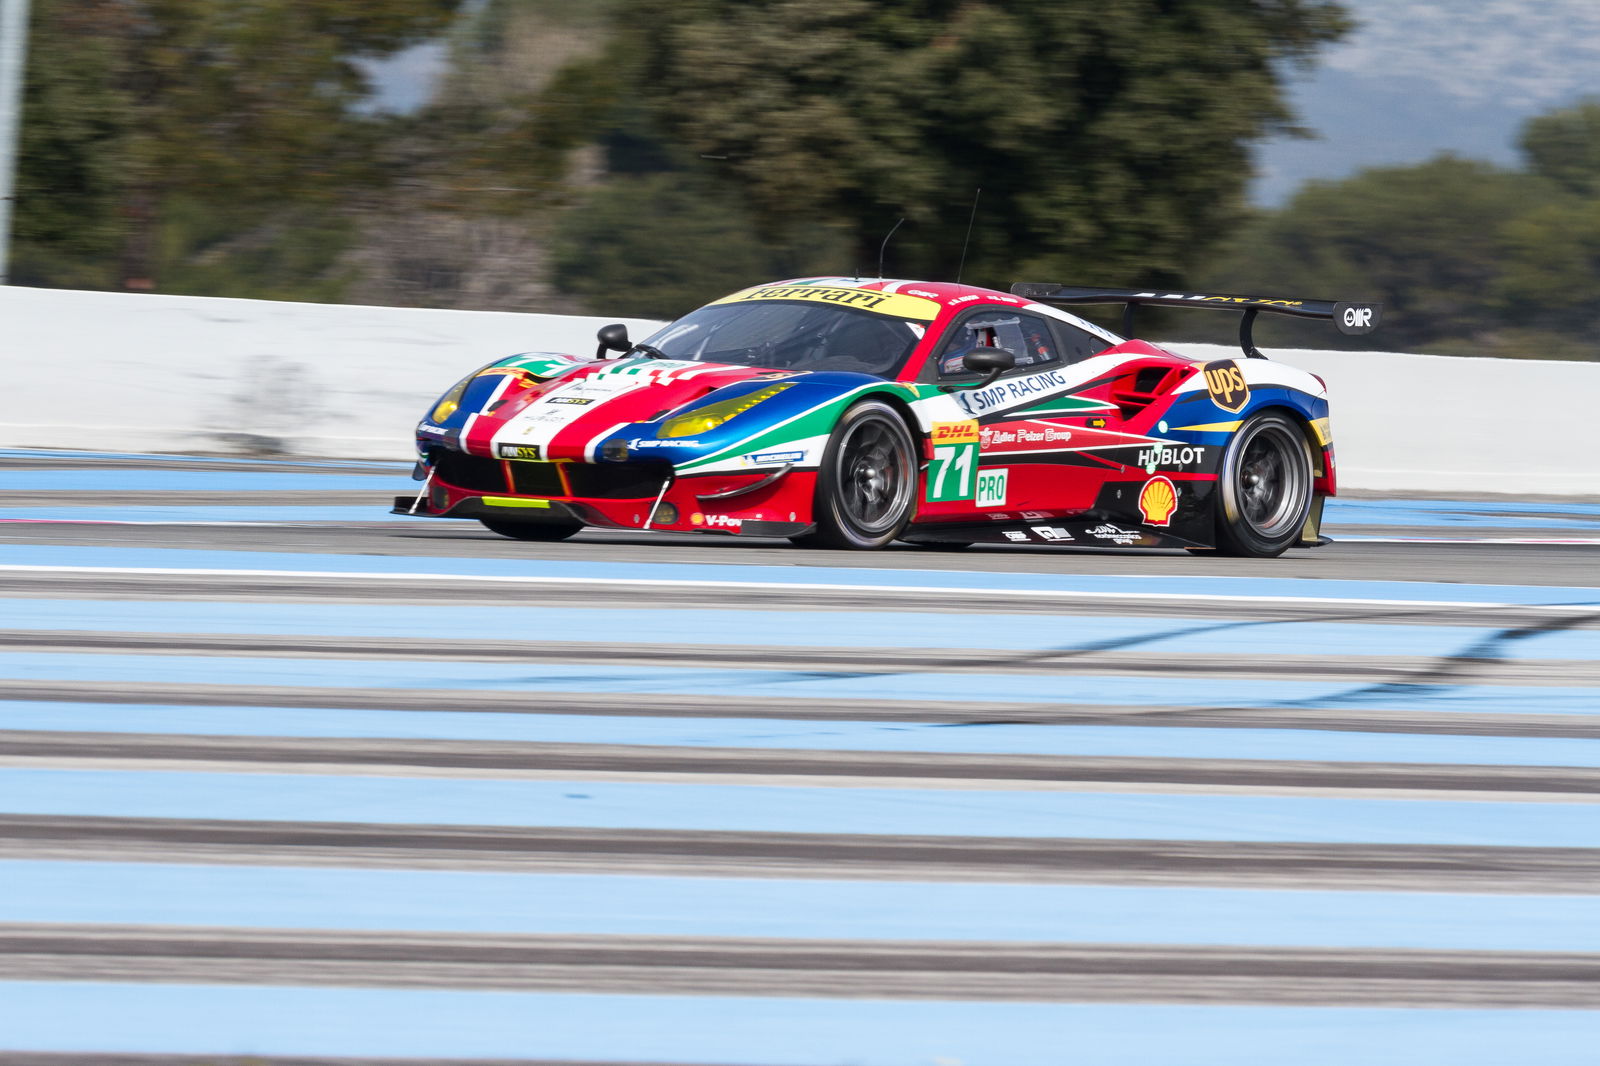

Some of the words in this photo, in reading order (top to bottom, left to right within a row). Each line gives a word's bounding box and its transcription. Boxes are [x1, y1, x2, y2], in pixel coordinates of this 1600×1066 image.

[744, 286, 893, 308] Ferrari
[973, 385, 1006, 410] SMP
[1007, 371, 1067, 398] RACING
[1205, 368, 1245, 403] ups
[937, 425, 975, 439] DHL
[992, 431, 1016, 444] Adler
[1017, 429, 1044, 442] Pelzer
[1045, 428, 1072, 442] Group
[1138, 447, 1204, 466] HUBLOT
[933, 445, 974, 498] 71
[978, 475, 1005, 501] PRO
